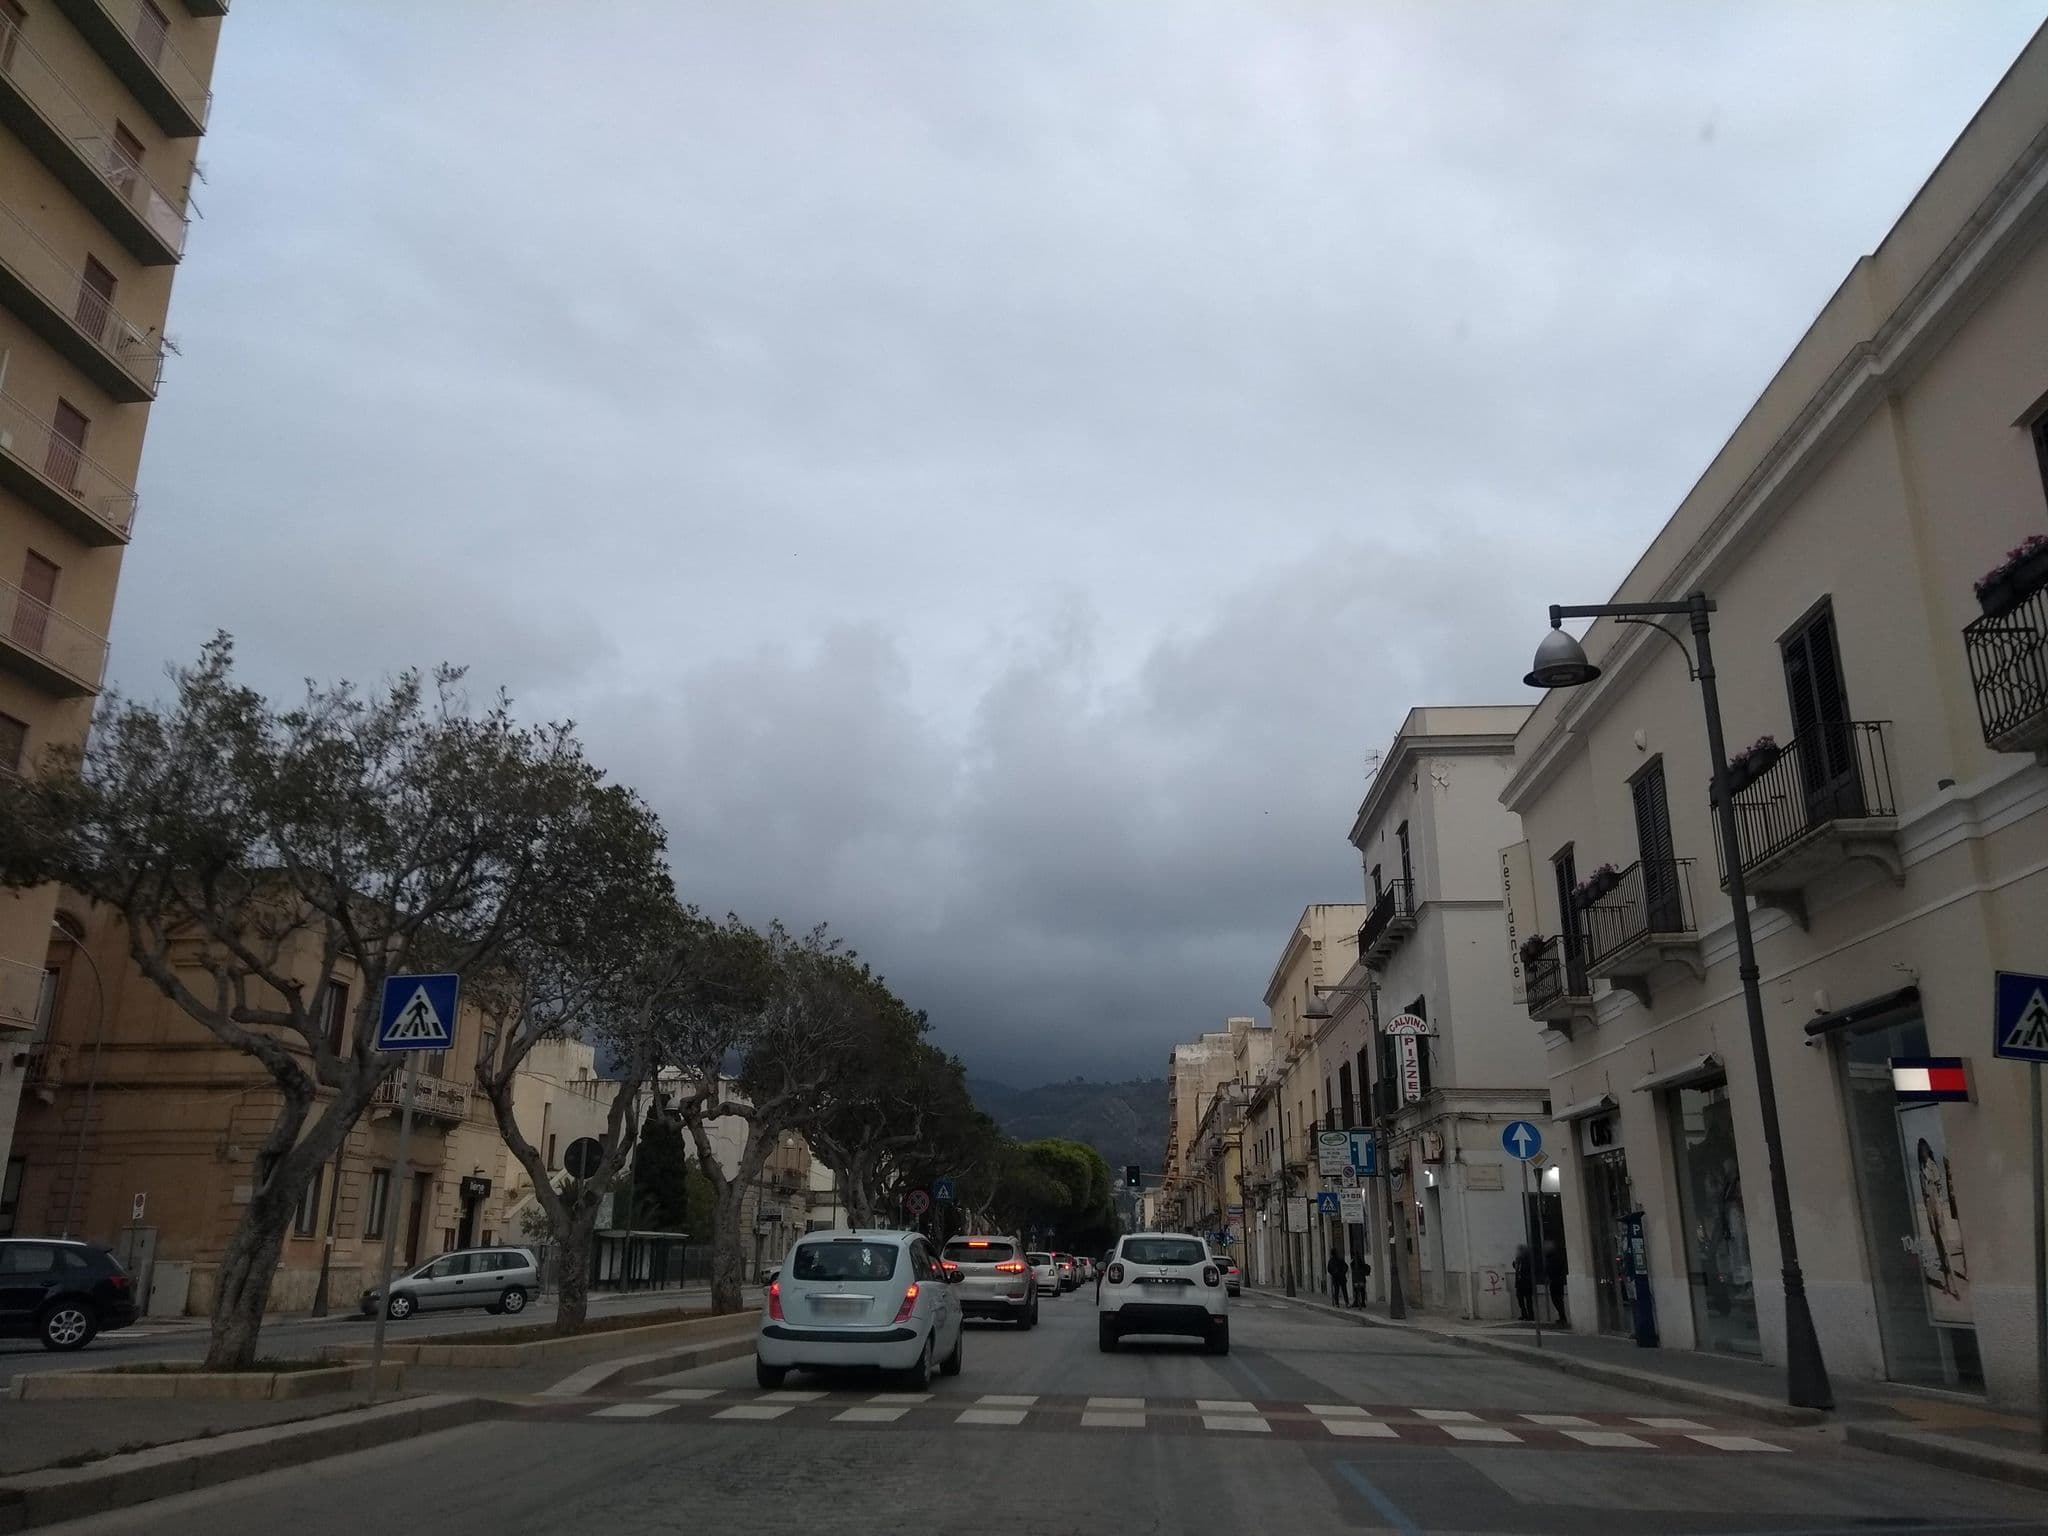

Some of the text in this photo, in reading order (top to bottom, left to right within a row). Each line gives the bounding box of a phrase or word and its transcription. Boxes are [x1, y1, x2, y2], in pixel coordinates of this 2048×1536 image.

[1502, 853, 1520, 978] residence
[1389, 1016, 1427, 1033] CALVINO
[1404, 1037, 1419, 1090] PIZZE
[1351, 1133, 1372, 1167] T
[1632, 1224, 1640, 1235] P
